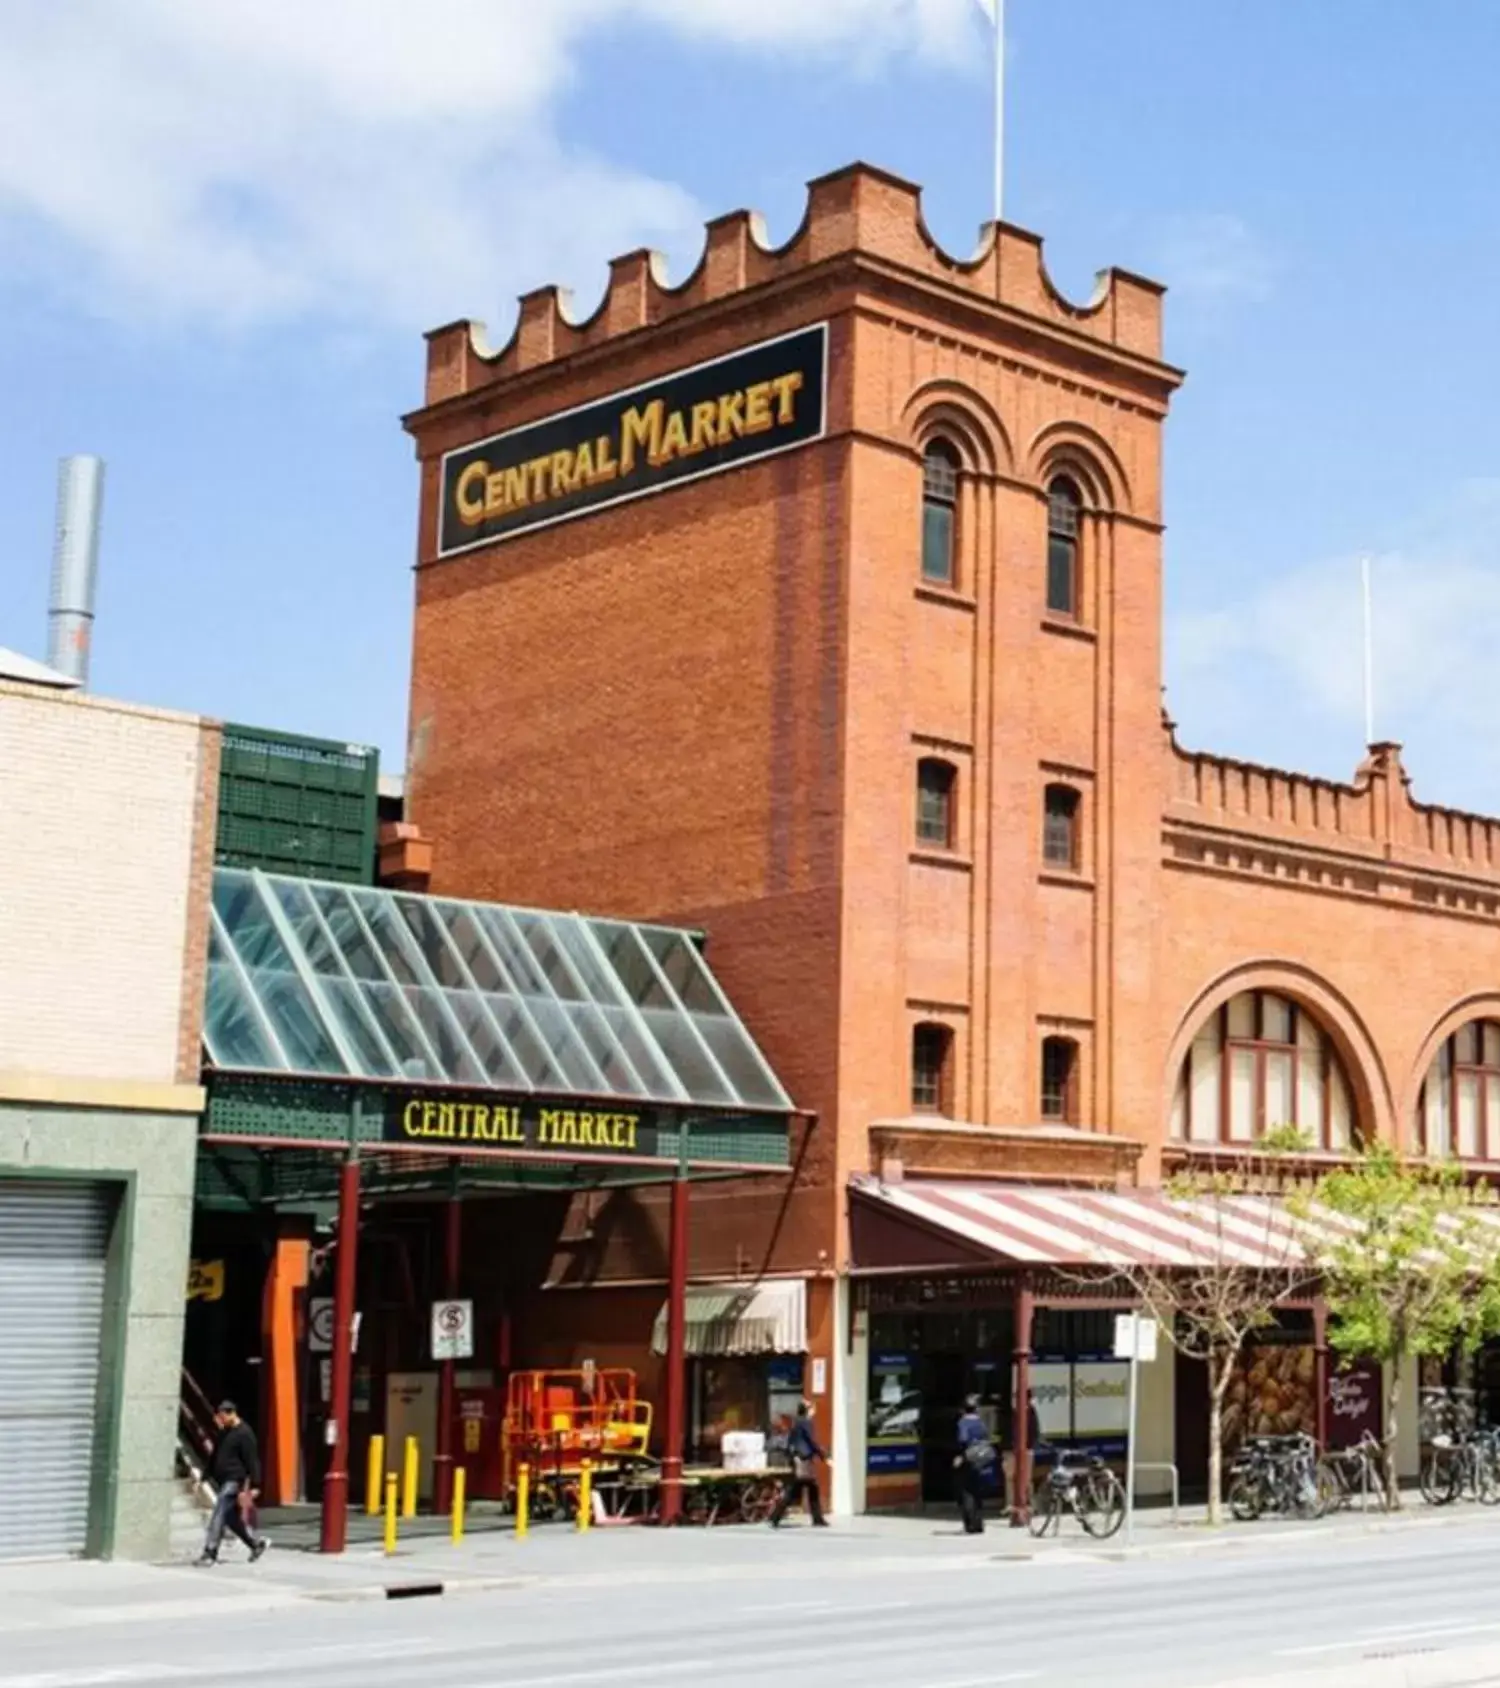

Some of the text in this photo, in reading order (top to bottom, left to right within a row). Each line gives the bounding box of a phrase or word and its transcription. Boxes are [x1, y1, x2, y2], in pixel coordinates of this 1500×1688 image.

[455, 371, 804, 526] CENTRAL MARKET
[403, 1100, 640, 1148] CENTRAL MARKET
